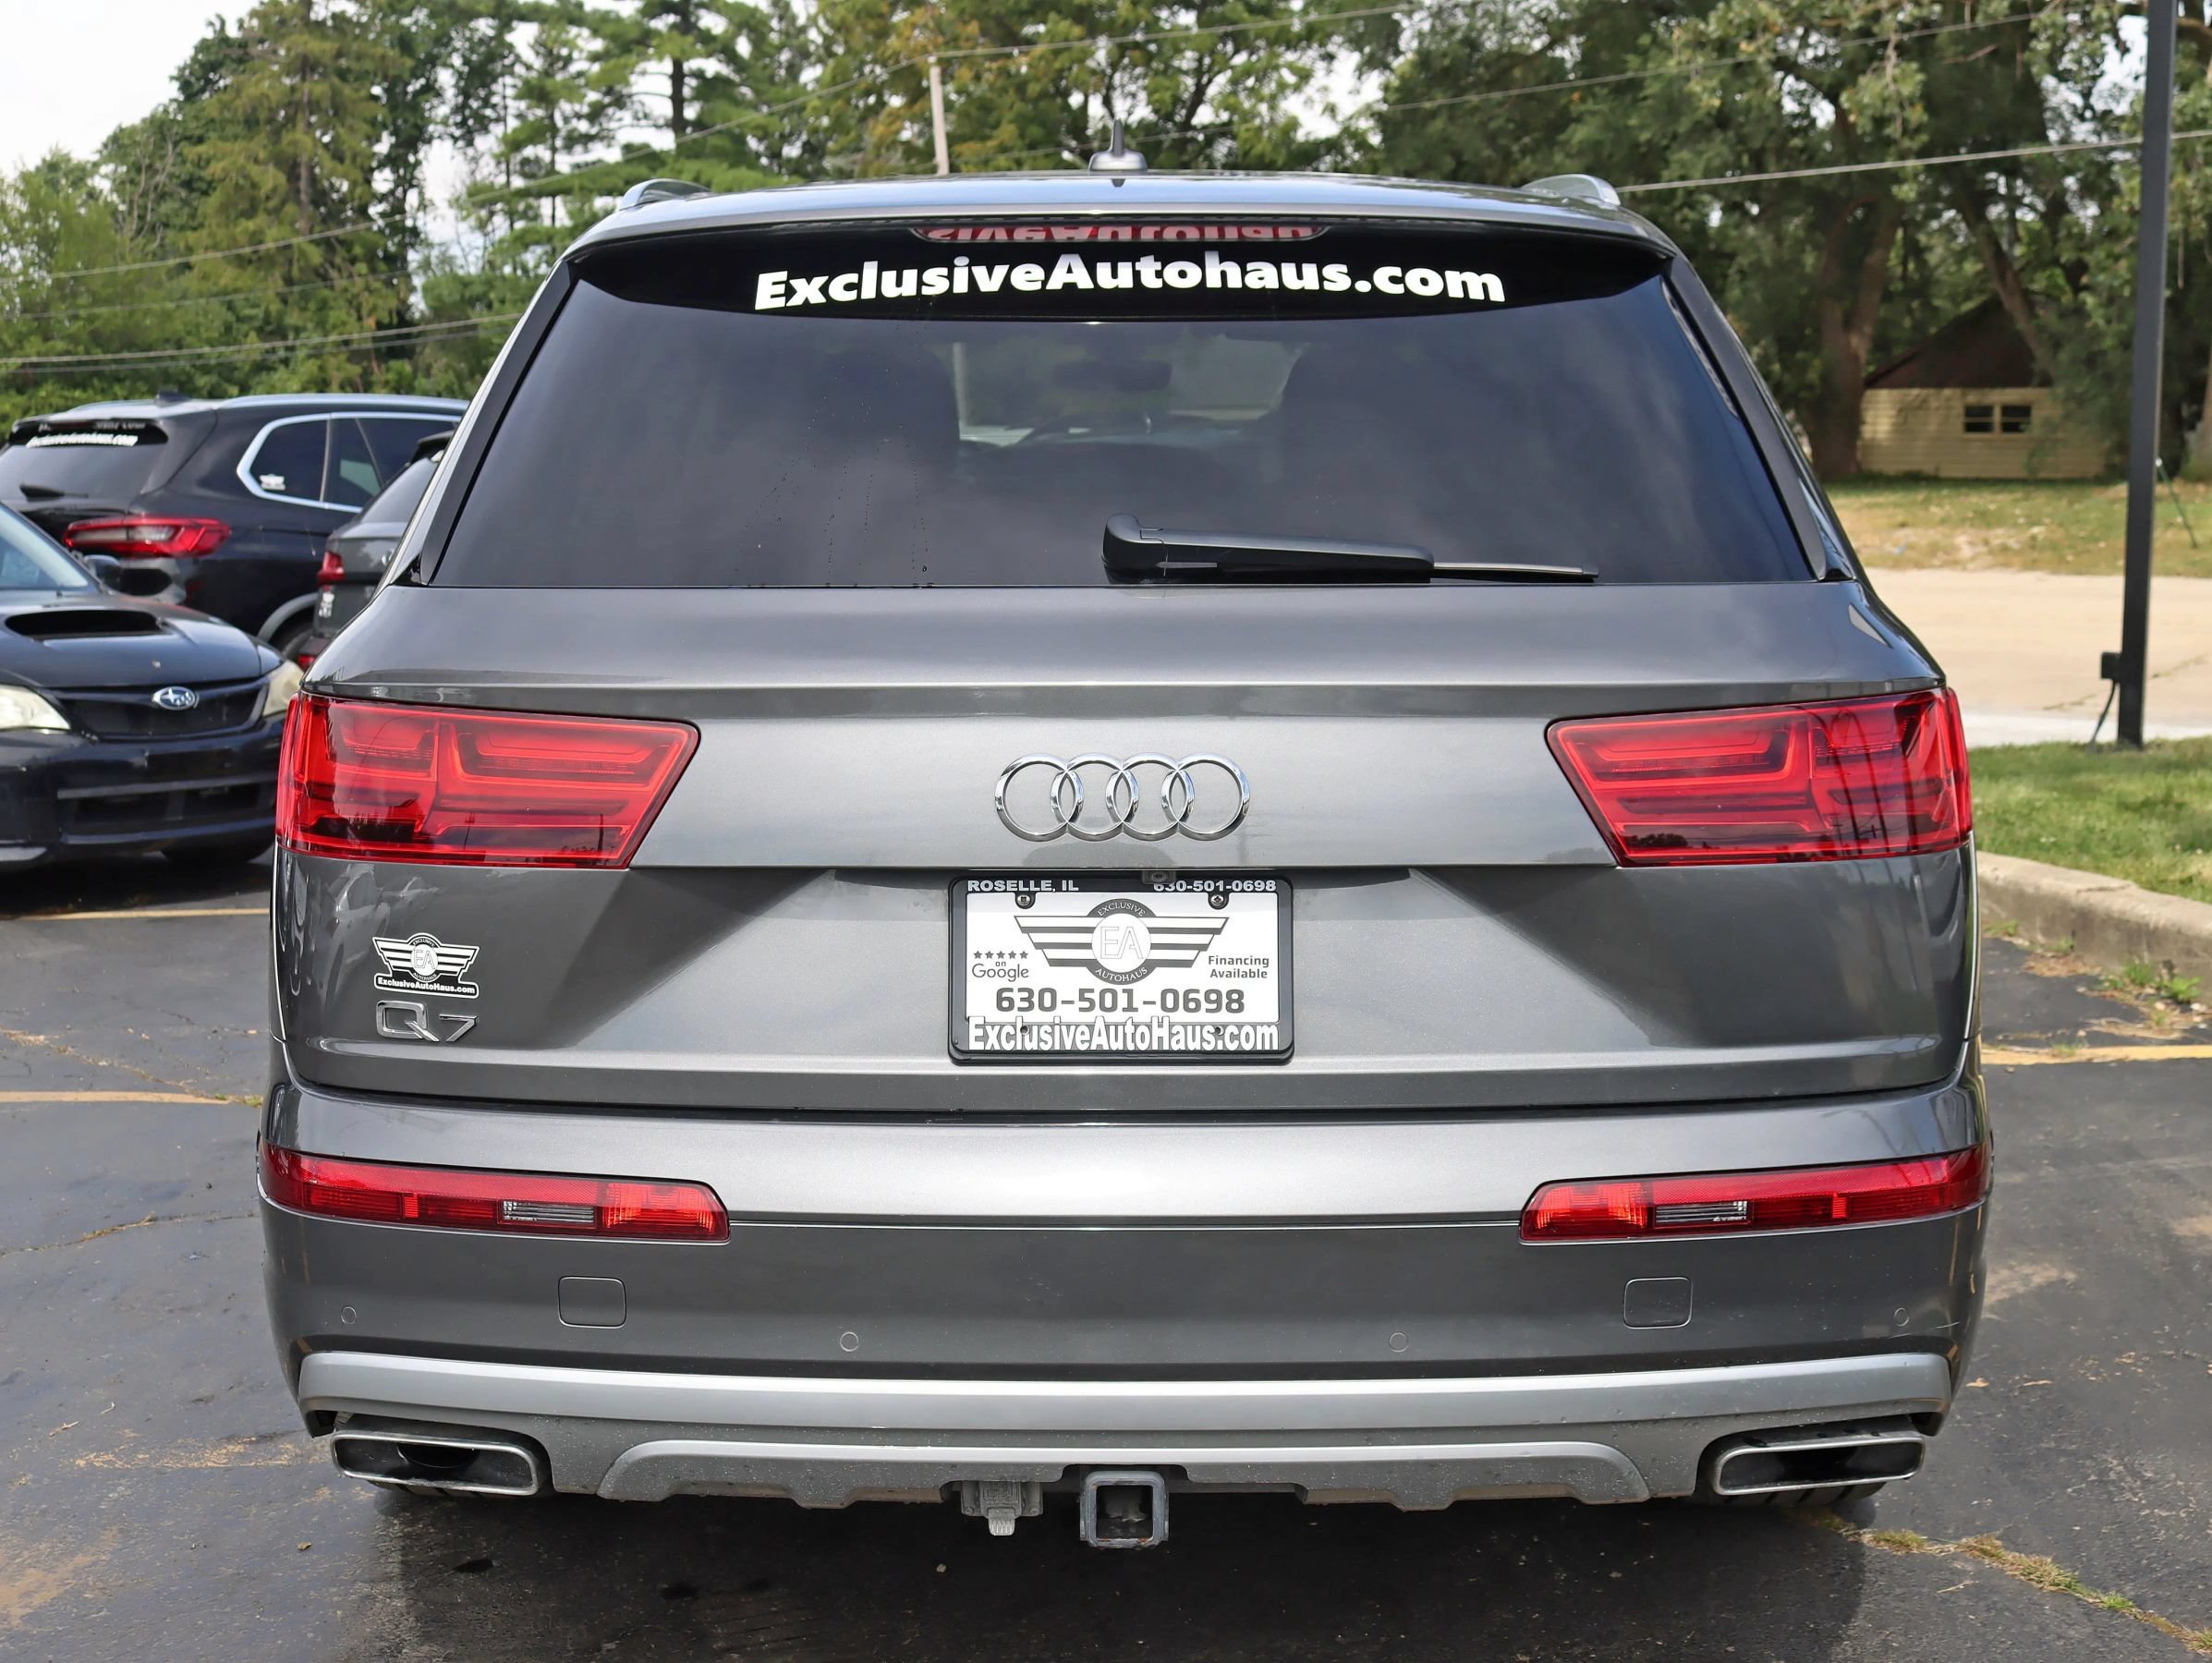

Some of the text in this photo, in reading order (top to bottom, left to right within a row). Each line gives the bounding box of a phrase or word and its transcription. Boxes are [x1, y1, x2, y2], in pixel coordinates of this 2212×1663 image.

[754, 250, 1506, 310] ExclusiveAutohaus.com
[967, 880, 1079, 892] ROSELLE, IL
[1097, 902, 1146, 917] EXCLUSIVE
[1100, 926, 1144, 960] EA
[1208, 955, 1270, 967] Financing
[971, 963, 1029, 982] Google
[1095, 966, 1148, 982] AUTOHAUS
[1209, 968, 1269, 978] Available
[377, 977, 476, 994] ExclusiveAutoHaus.com
[996, 988, 1246, 1014] 630-501-0698
[375, 1000, 478, 1041] Q7
[968, 1015, 1279, 1051] ExclusiveAutoHaus.com
